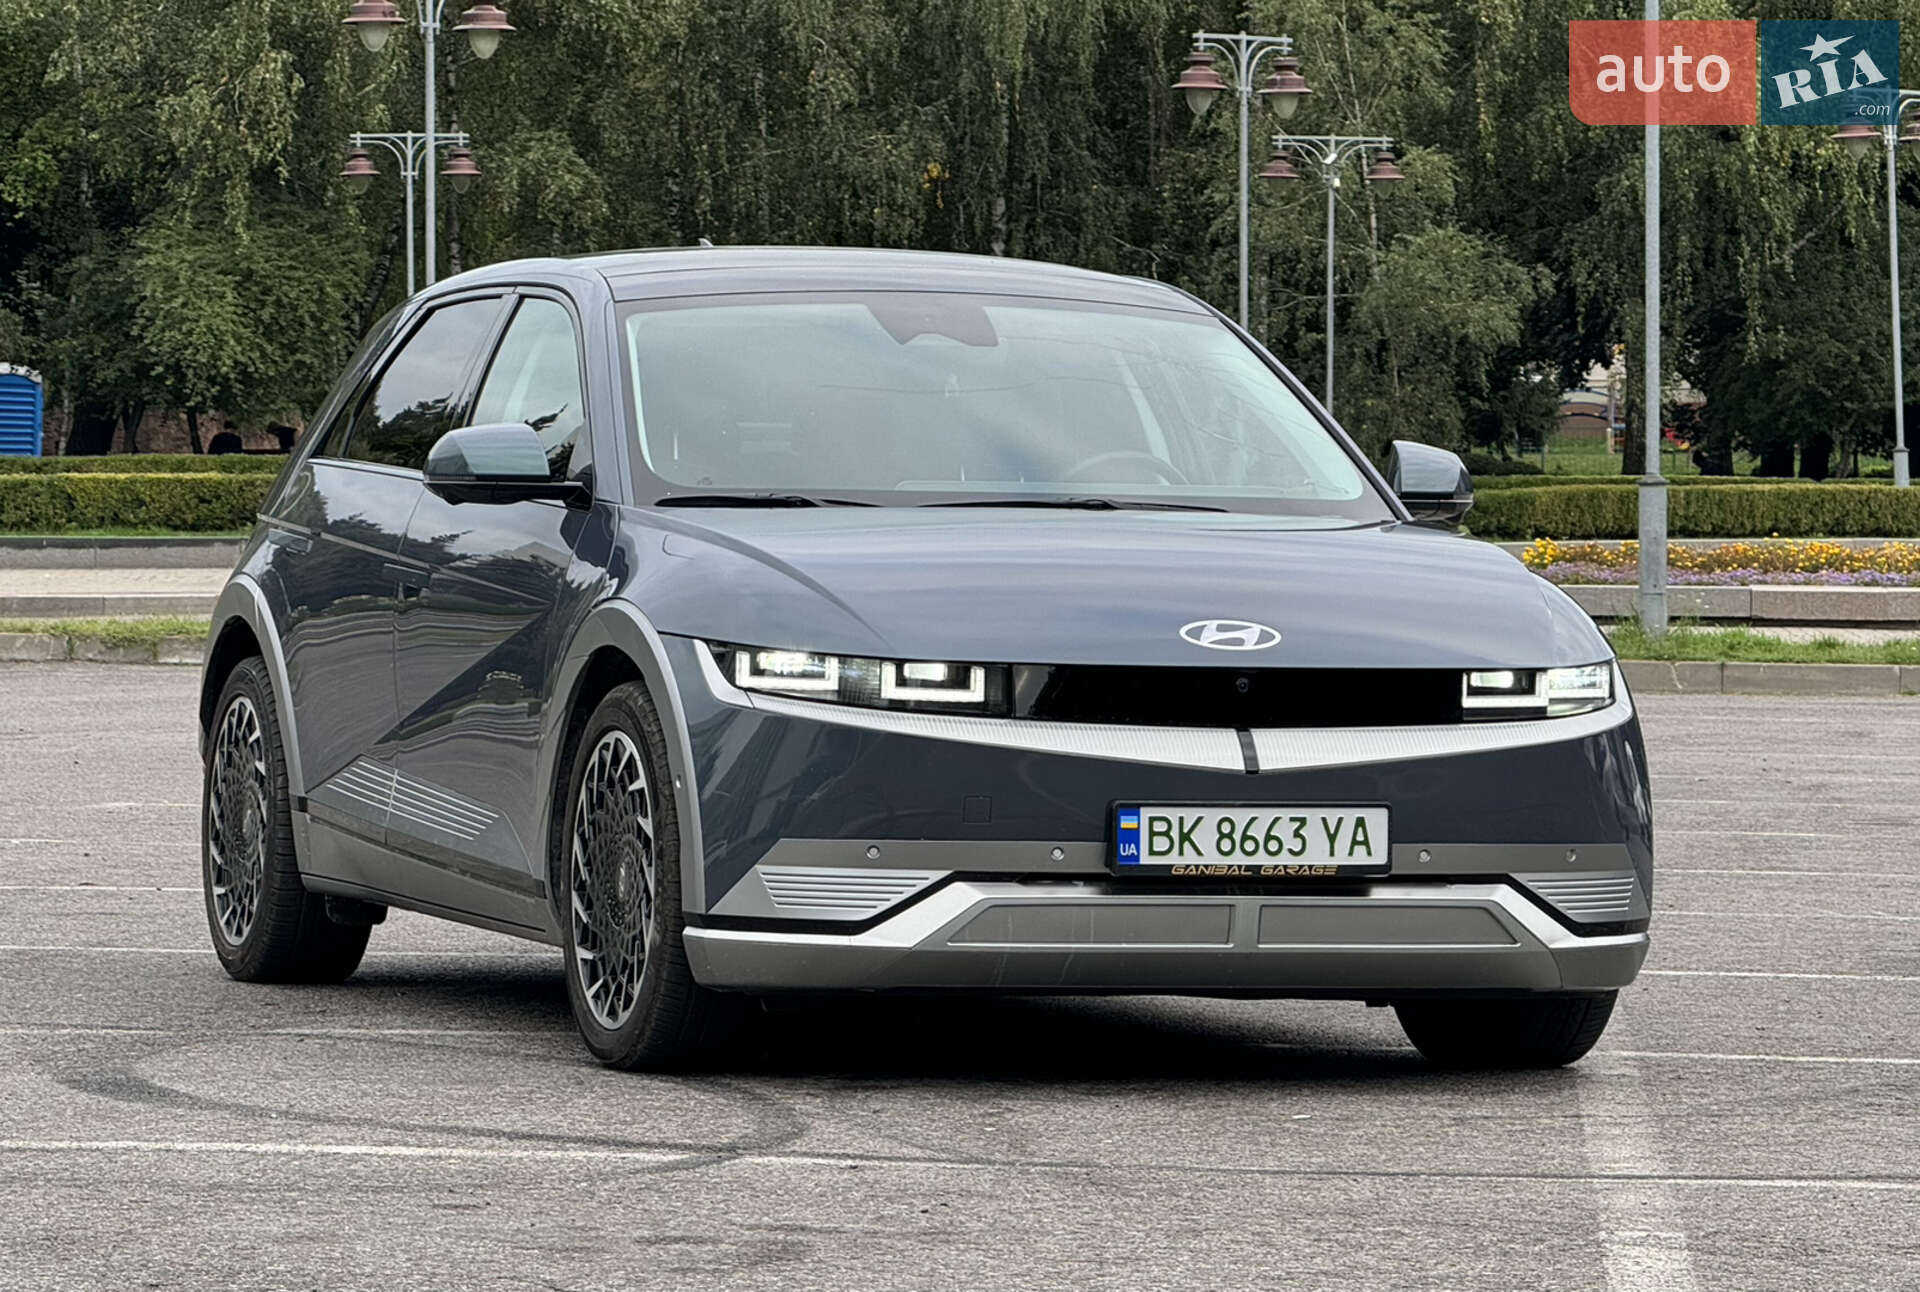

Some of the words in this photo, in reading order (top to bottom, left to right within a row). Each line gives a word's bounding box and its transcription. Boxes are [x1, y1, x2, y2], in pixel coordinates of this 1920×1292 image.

[1148, 816, 1205, 857] BK
[1216, 816, 1308, 857] 8663
[1321, 816, 1373, 857] YA
[1120, 843, 1138, 856] UA
[1171, 864, 1253, 876] GANIBAL
[1260, 864, 1339, 876] GARAGE
